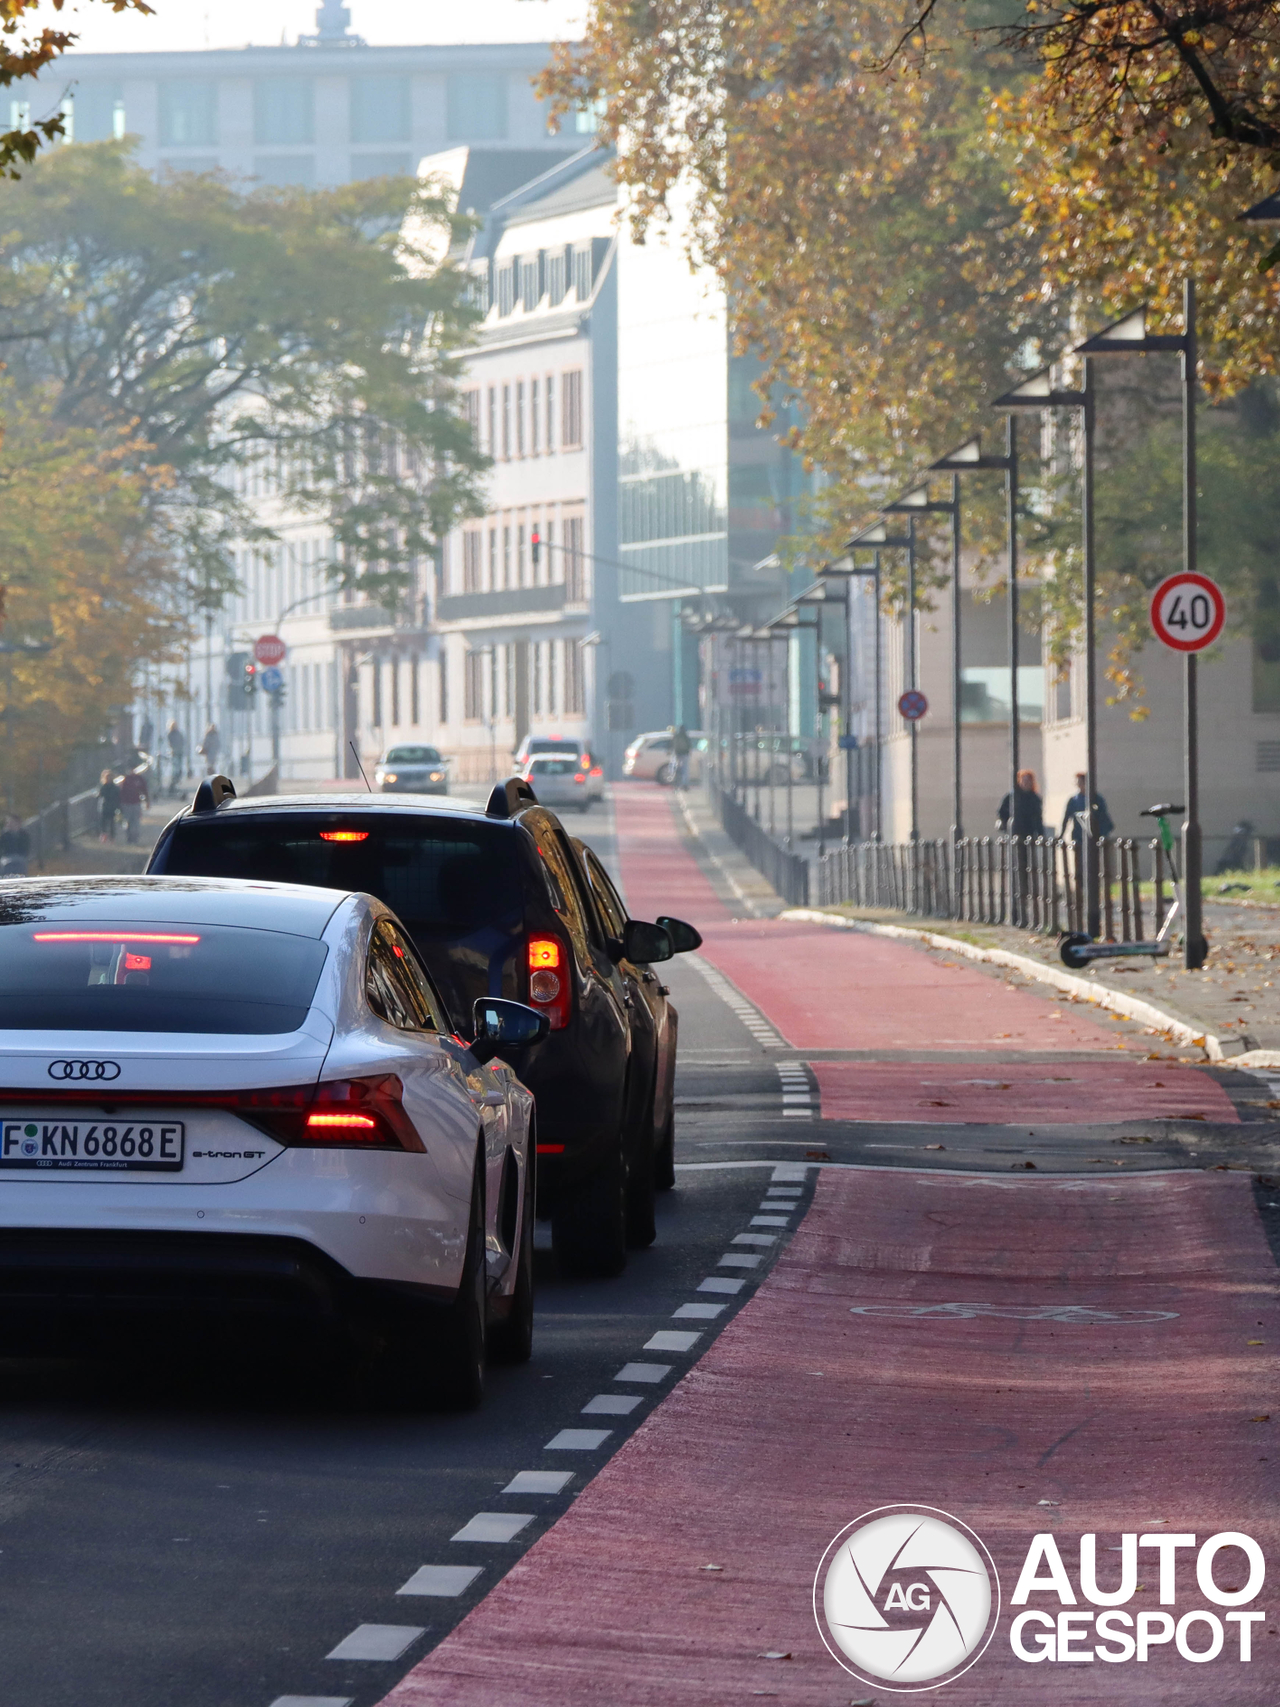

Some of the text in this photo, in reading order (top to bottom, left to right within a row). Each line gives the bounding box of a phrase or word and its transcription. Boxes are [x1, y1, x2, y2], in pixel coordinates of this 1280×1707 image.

[1167, 593, 1210, 630] 40
[4, 1125, 22, 1156] F
[58, 1160, 73, 1168] Audi
[100, 1161, 129, 1169] Frankfurt
